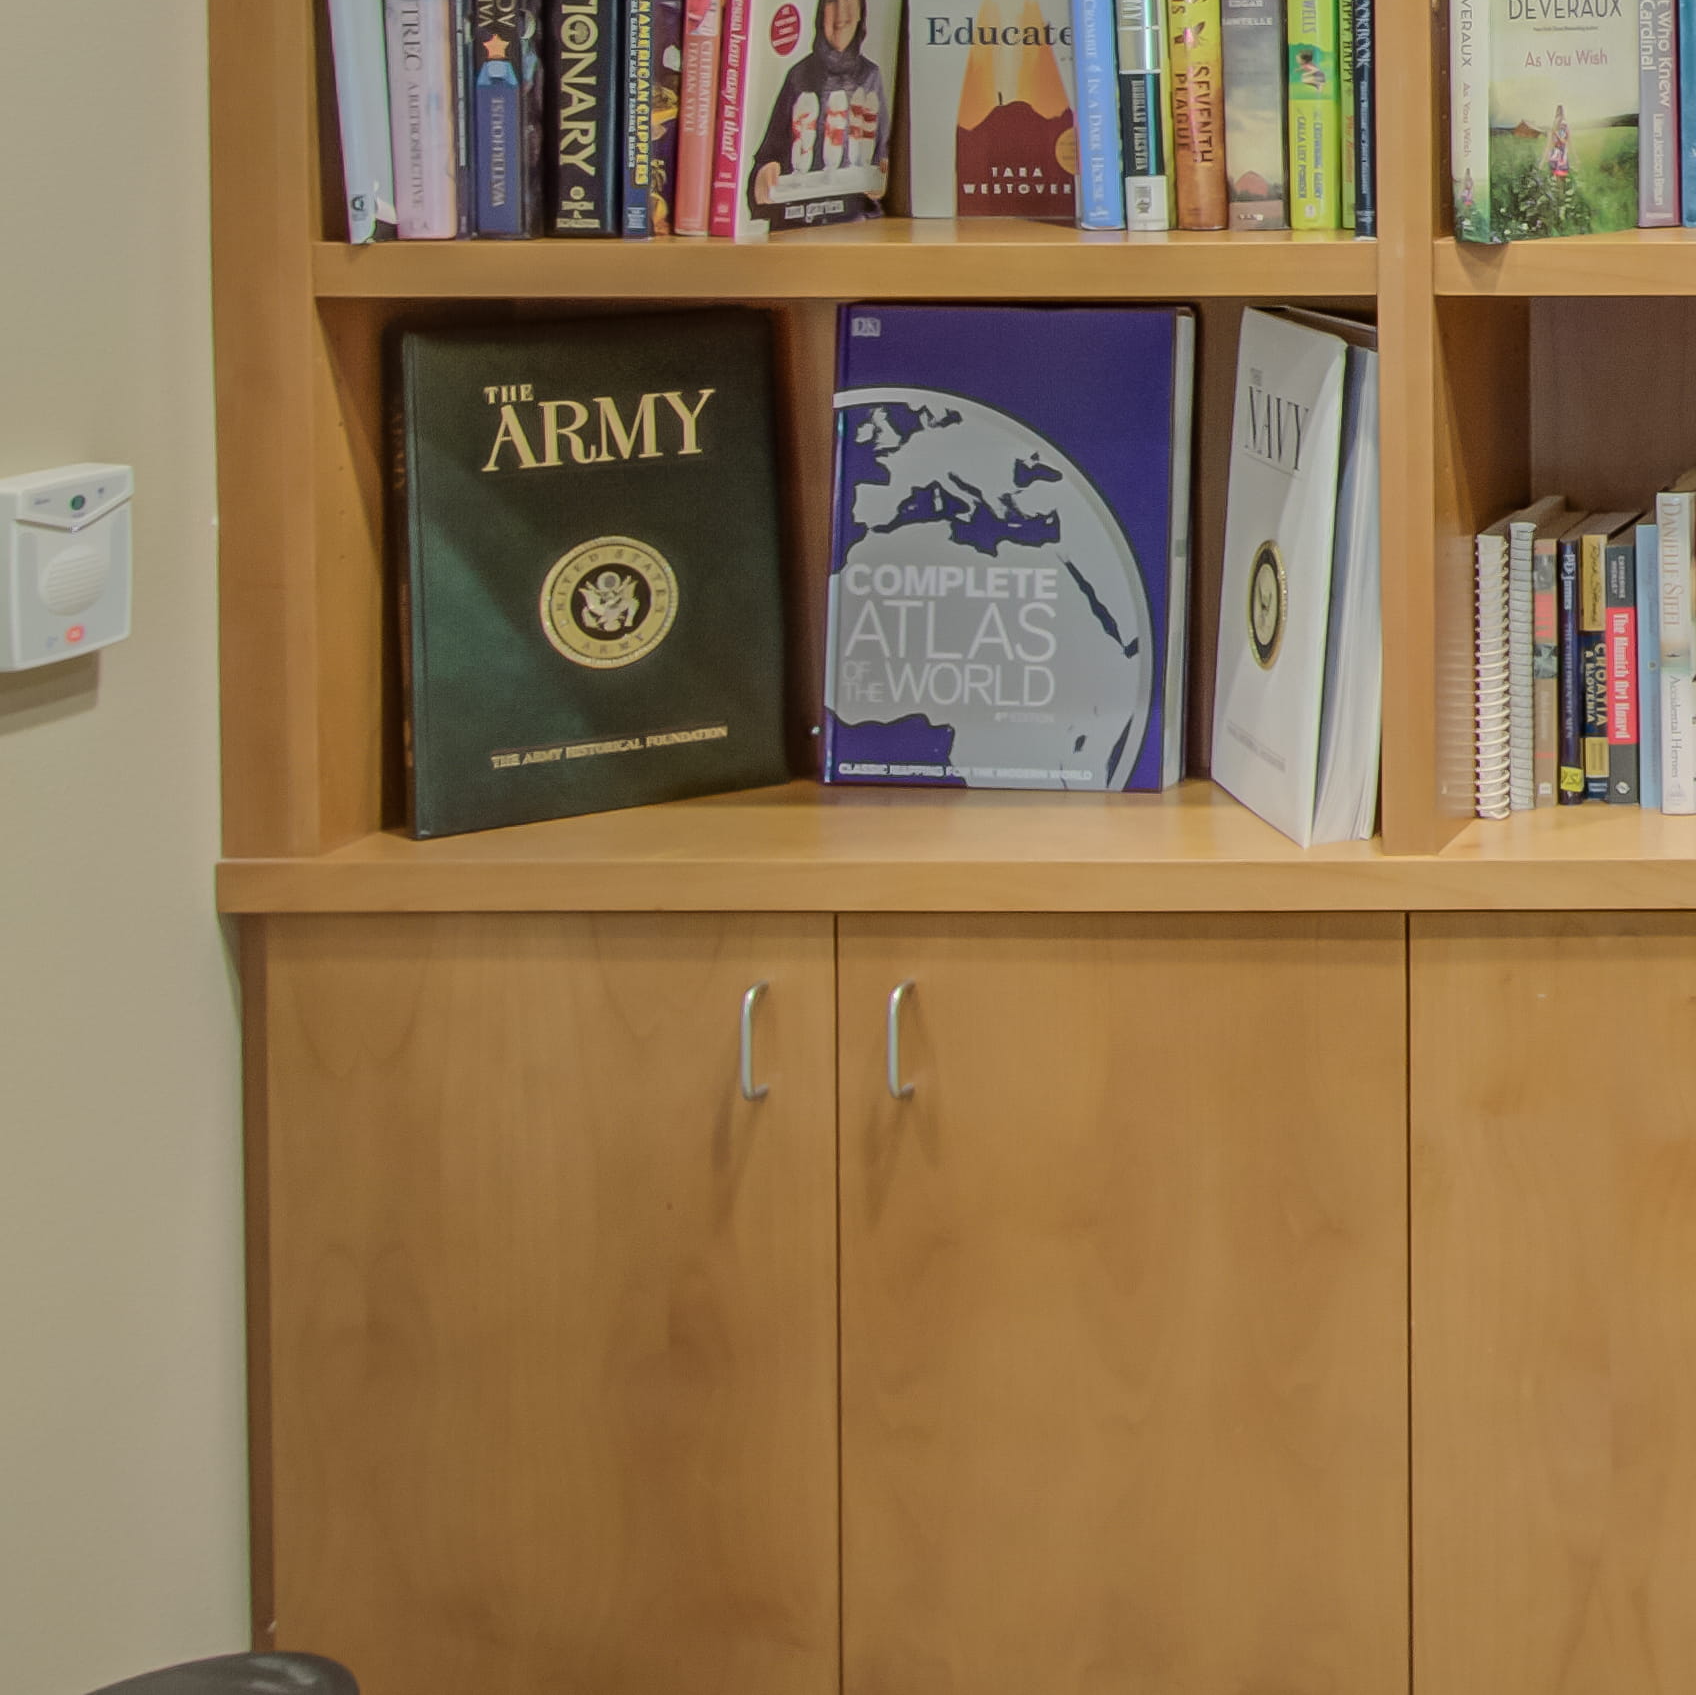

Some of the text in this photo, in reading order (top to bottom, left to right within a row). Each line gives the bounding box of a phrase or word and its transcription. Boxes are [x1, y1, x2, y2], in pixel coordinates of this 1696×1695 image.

[927, 17, 1072, 46] Educate
[1640, 0, 1656, 70] Cardinal
[1658, 12, 1671, 51] Who
[729, 34, 745, 64] how
[1525, 48, 1608, 67] As You Wish
[723, 69, 741, 103] easy
[1659, 58, 1672, 107] Knew
[724, 106, 738, 117] is
[721, 120, 737, 160] that?
[963, 182, 1072, 195] WESTOVER
[992, 167, 1043, 178] TARA
[484, 384, 533, 404] THE
[481, 389, 716, 472] ARMY
[1246, 385, 1310, 472] NAVY
[845, 565, 1057, 599] COMPLETE
[845, 601, 1057, 662] ATLAS
[843, 662, 871, 682] OF
[843, 663, 1054, 706] THE WORLD
[491, 725, 728, 770] THE ARMY HISTORICAL FOUNDATION
